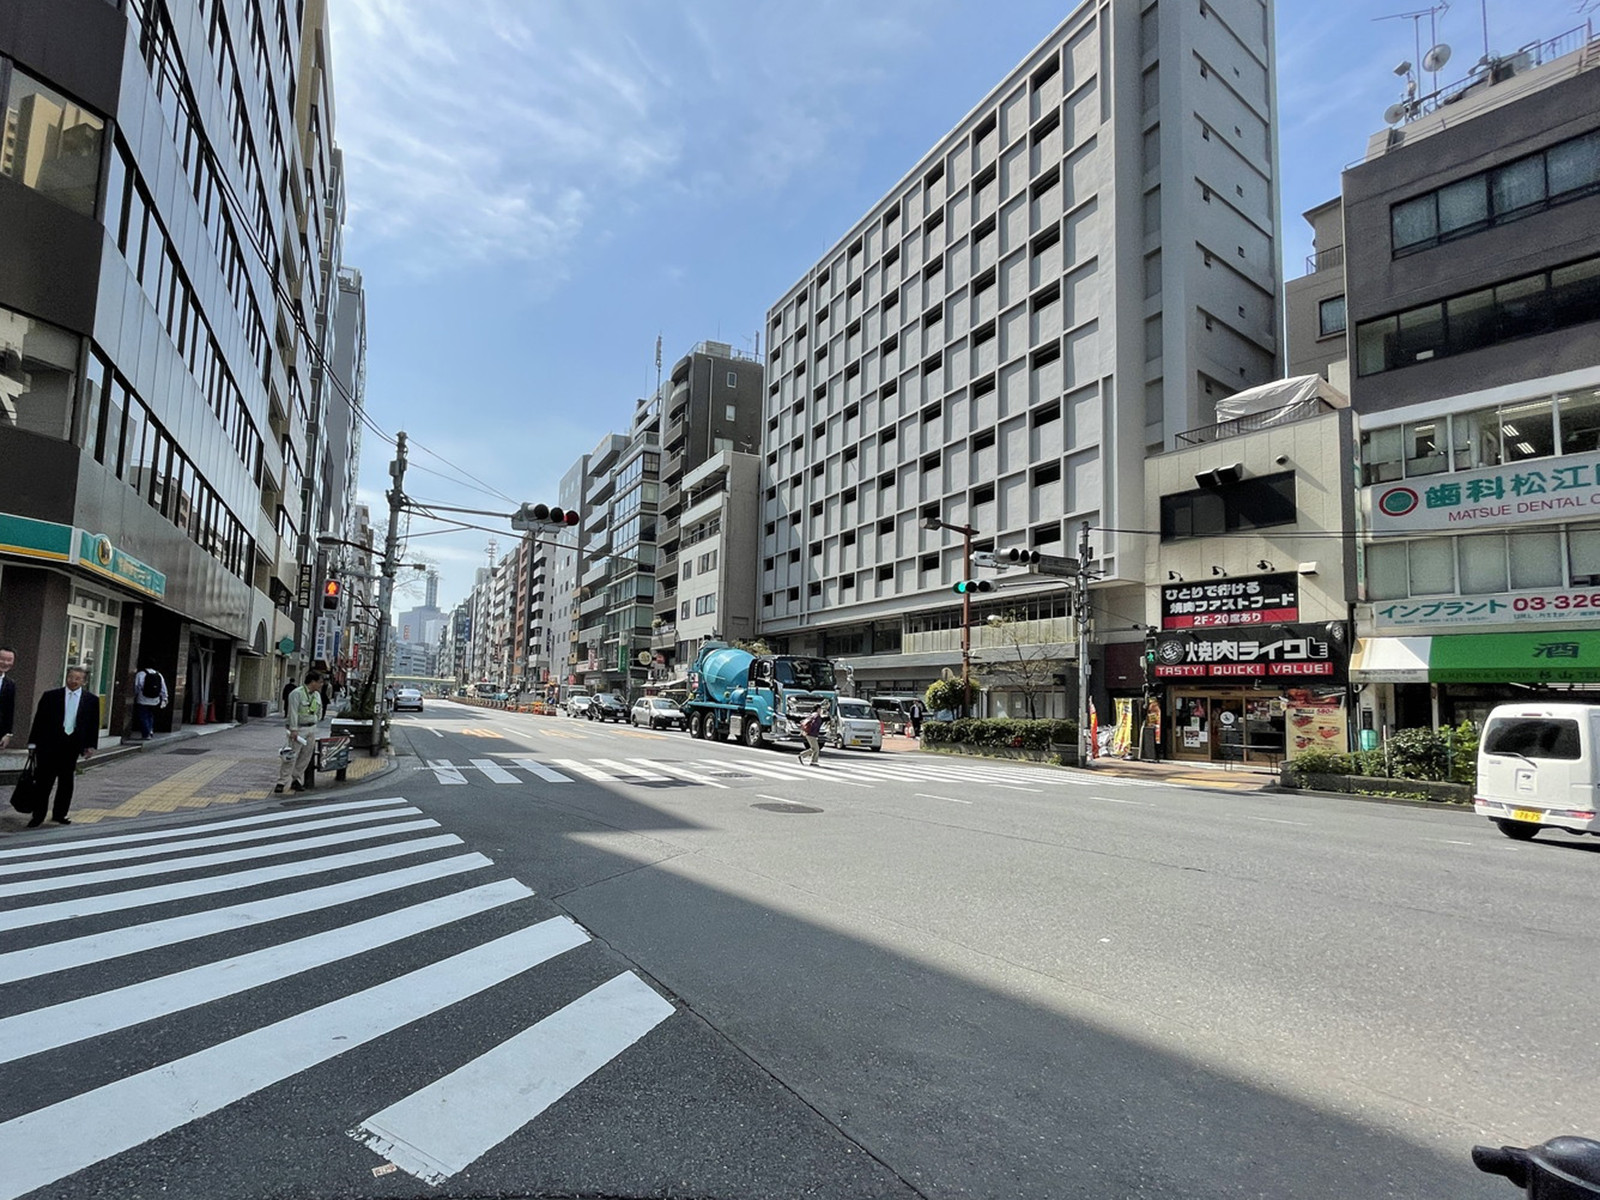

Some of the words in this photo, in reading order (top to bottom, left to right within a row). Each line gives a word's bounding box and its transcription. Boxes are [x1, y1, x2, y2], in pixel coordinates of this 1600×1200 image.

[1425, 465, 1600, 509] 歯科松江
[1448, 505, 1512, 522] MATSUE
[1516, 496, 1587, 514] DENTAL
[1165, 581, 1261, 601] ひとりで行ける
[1169, 593, 1295, 614] 焼肉ファストフード
[1378, 599, 1507, 618] インプラント
[1513, 593, 1600, 611] 03-326
[1185, 638, 1308, 662] 焼肉ライク
[1532, 641, 1580, 660] 酒
[1158, 665, 1204, 675] TASTY!
[1213, 664, 1261, 675] QUICK!
[1272, 663, 1330, 674] VALUE!
